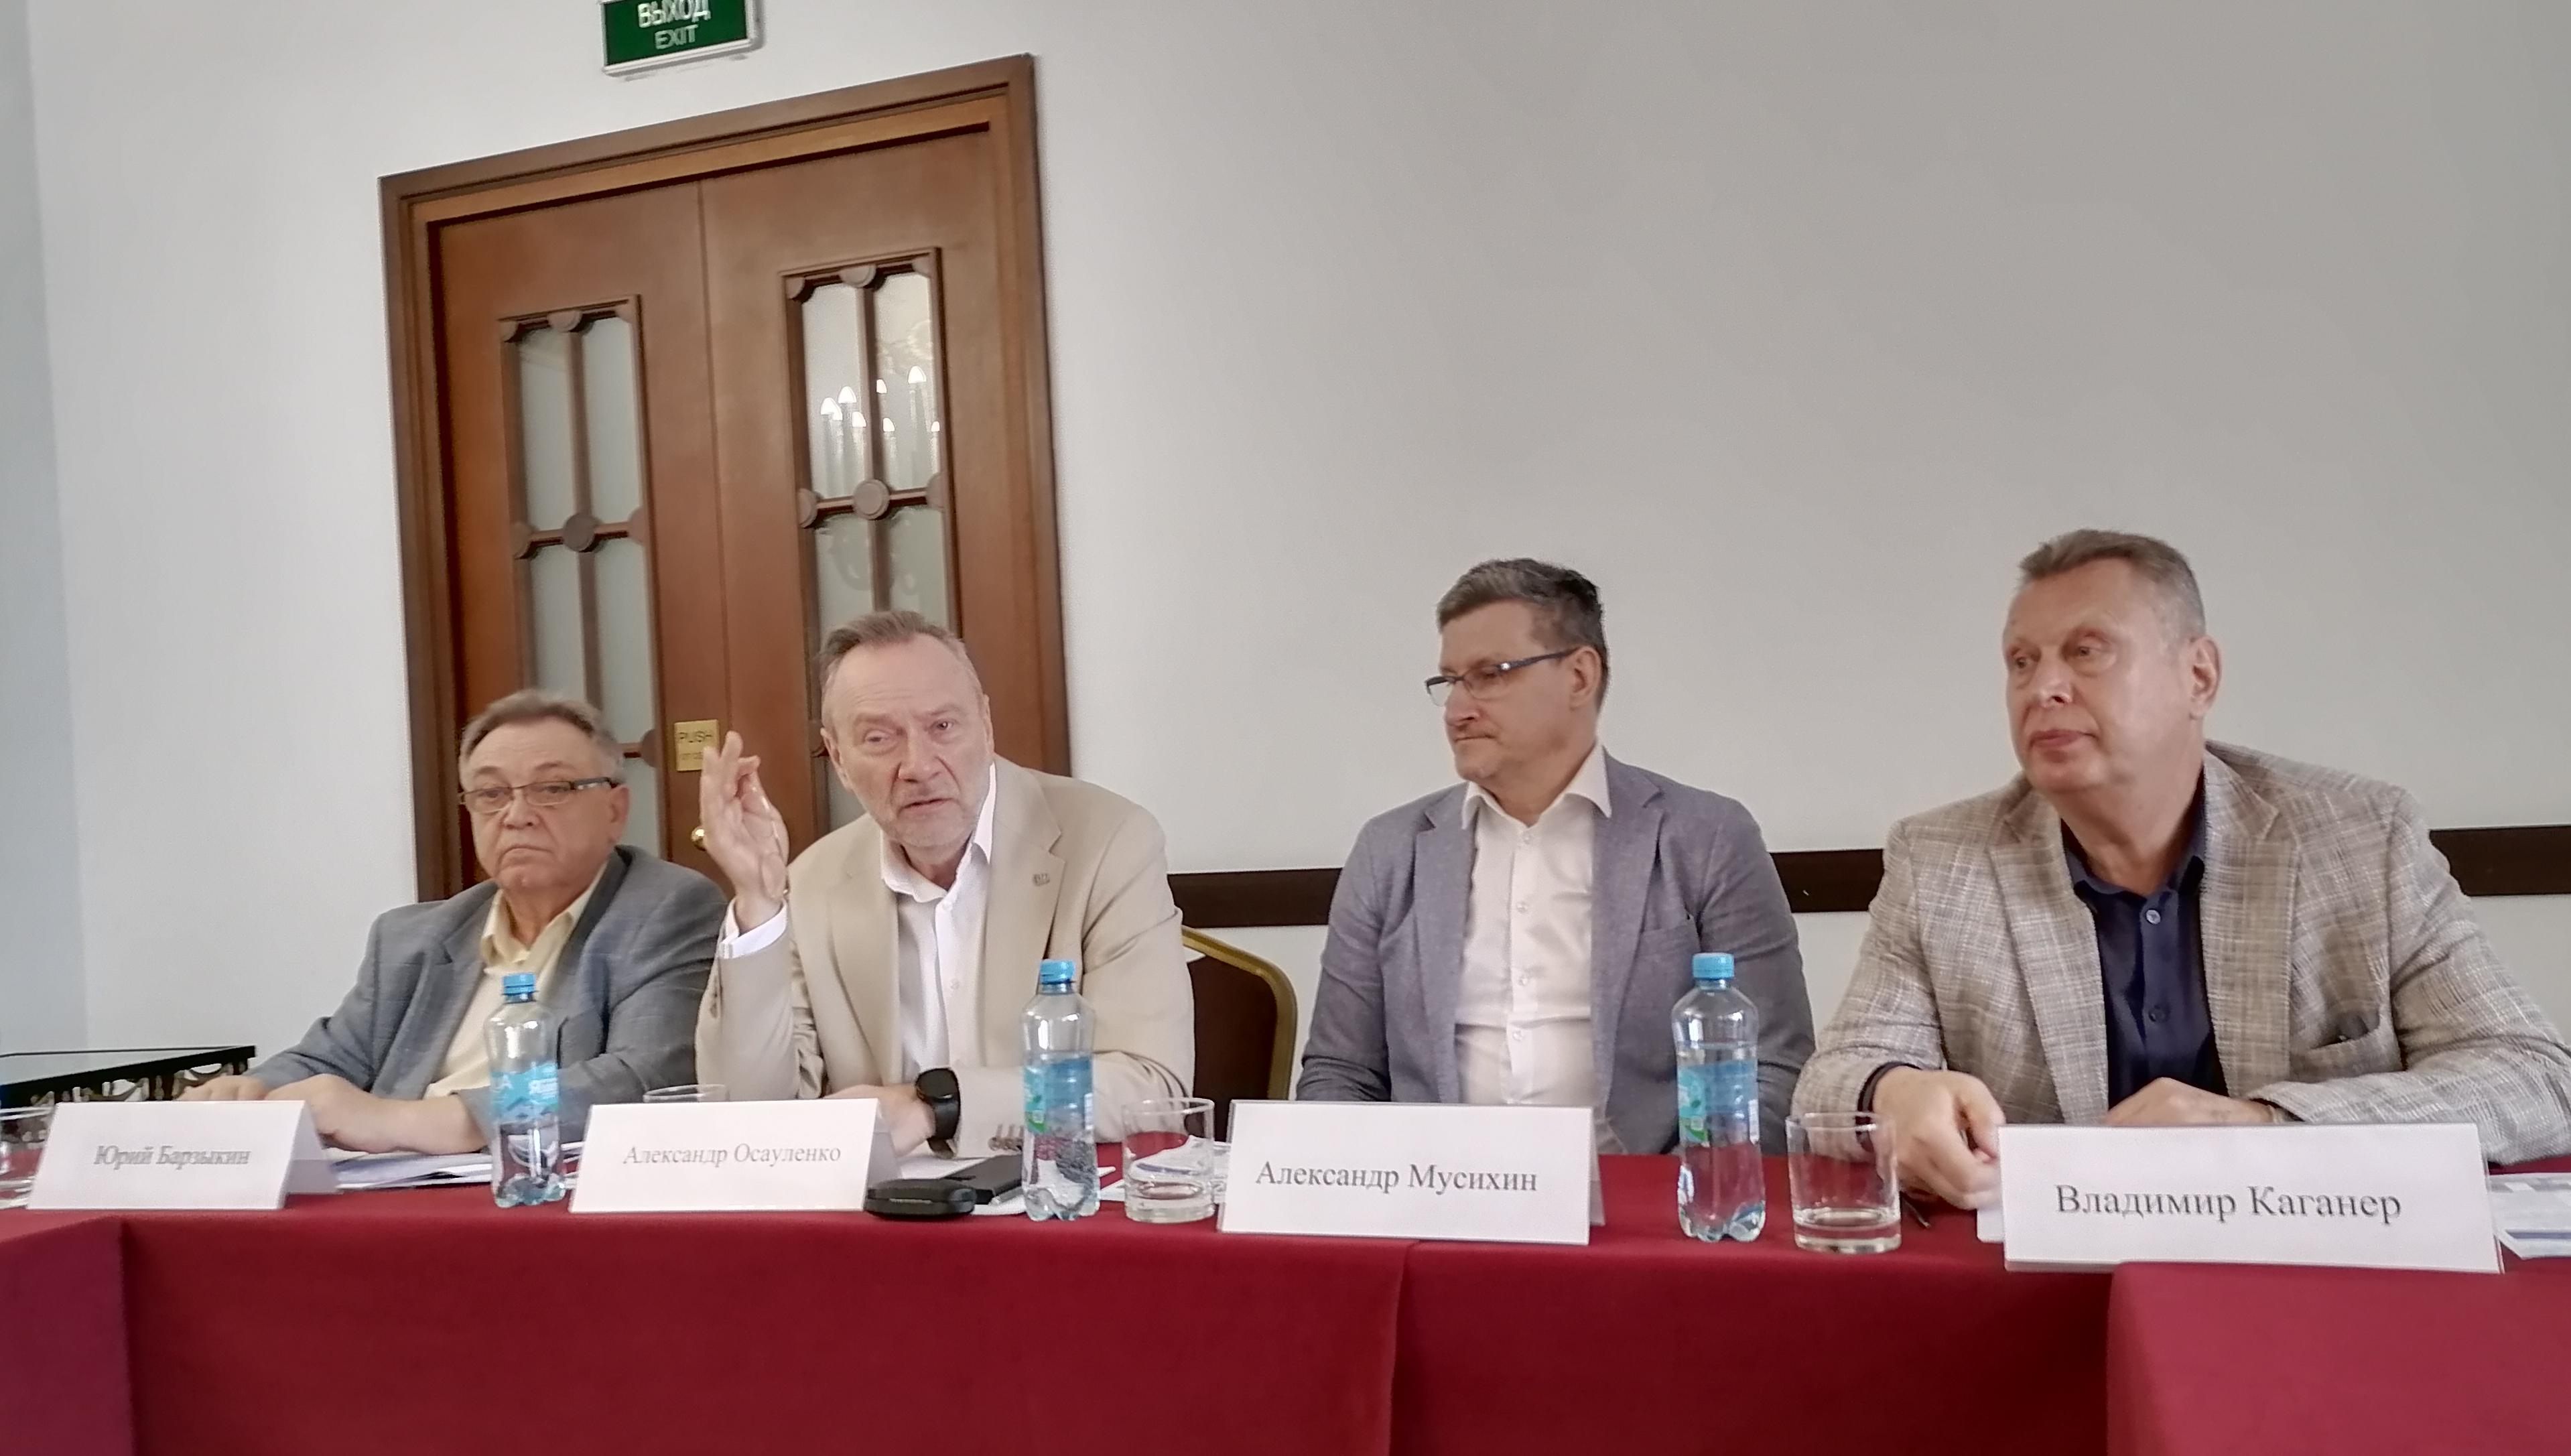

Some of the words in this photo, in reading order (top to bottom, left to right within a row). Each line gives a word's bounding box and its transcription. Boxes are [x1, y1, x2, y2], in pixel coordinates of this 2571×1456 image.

[637, 0, 711, 28] ВЫХОД
[655, 24, 698, 50] EXIT
[93, 1144, 153, 1171] Юрий
[155, 1145, 252, 1171] Барзыкин
[623, 1146, 728, 1168] Александр
[733, 1143, 842, 1167] Осауленко
[1255, 1161, 1400, 1194] Александр
[1407, 1163, 1538, 1195] Мусихин
[2055, 1184, 2237, 1223] Владимир
[2247, 1185, 2402, 1226] Каганер
